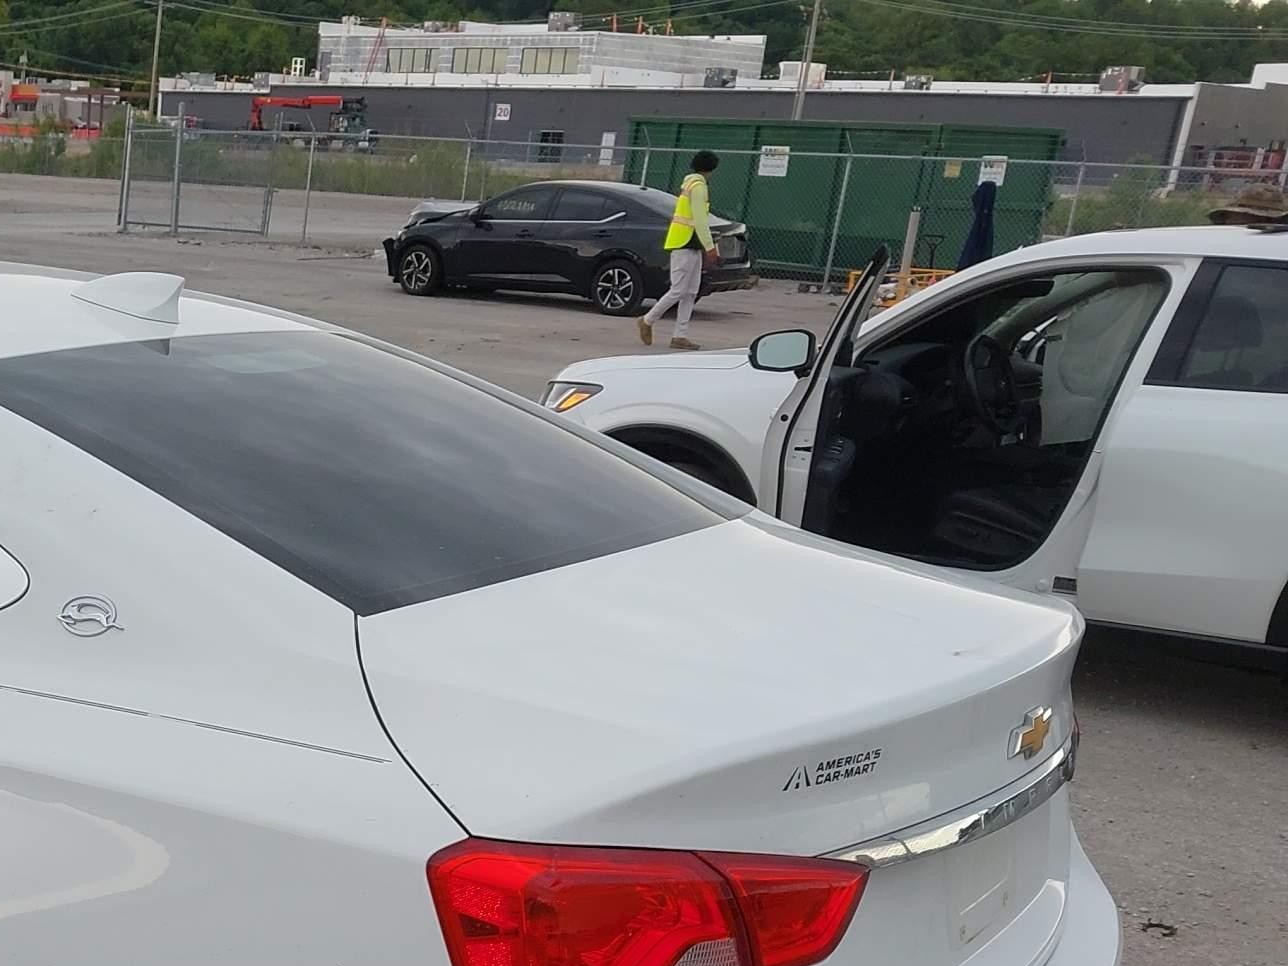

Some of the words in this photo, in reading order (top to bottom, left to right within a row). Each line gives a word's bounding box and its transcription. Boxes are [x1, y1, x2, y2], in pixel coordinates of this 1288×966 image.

[497, 107, 509, 117] 20
[815, 748, 882, 772] AMERICA'S
[815, 761, 877, 785] CAR-MART
